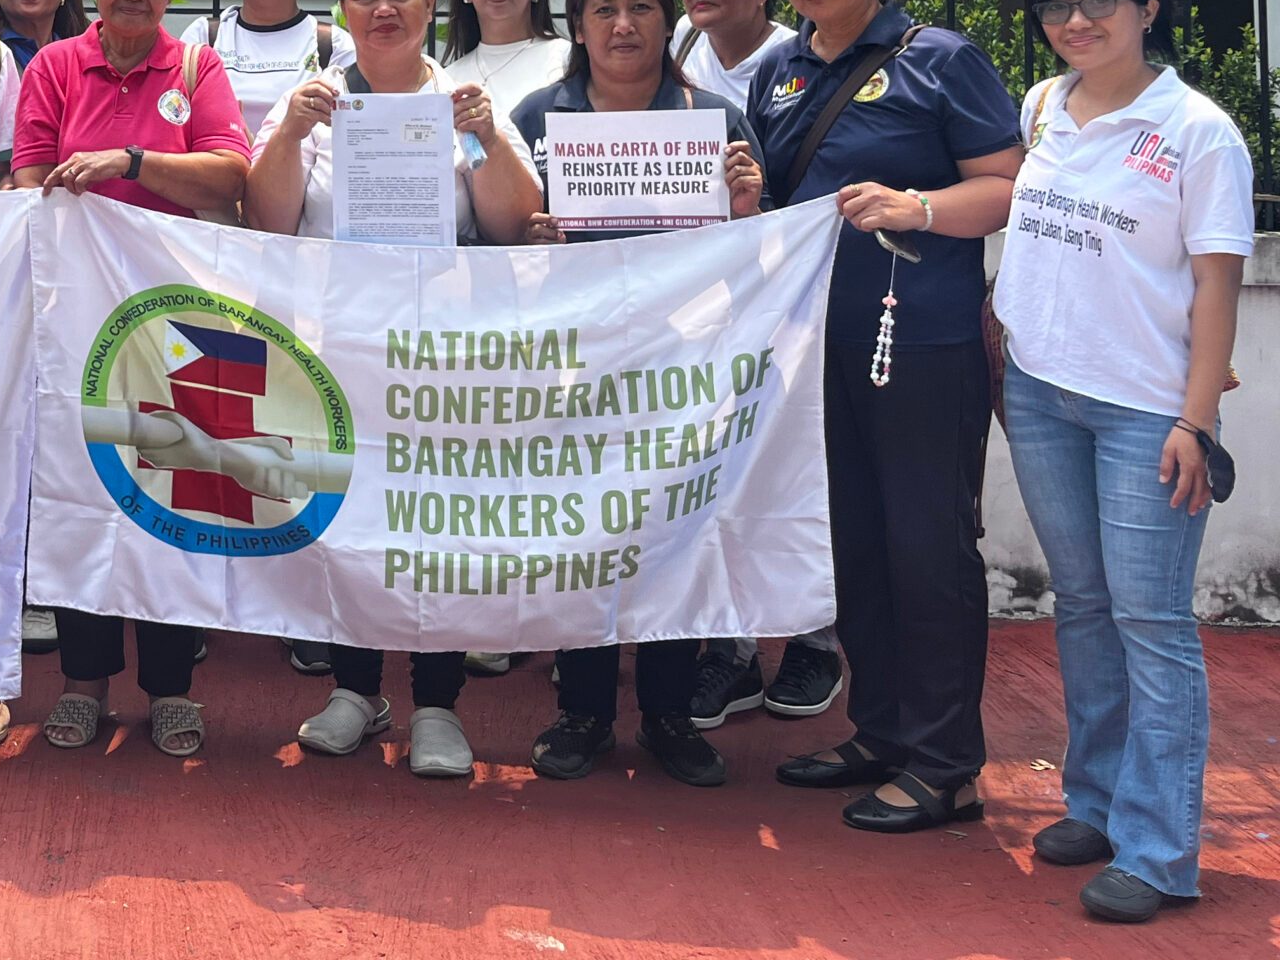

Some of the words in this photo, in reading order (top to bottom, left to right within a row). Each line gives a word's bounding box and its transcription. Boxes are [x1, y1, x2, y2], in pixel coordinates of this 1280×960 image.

[554, 142, 605, 157] MAGNA
[610, 142, 658, 157] CARTA
[664, 141, 681, 156] OF
[687, 141, 720, 156] BHW
[1130, 131, 1165, 160] UNI
[1161, 145, 1182, 159] global
[562, 162, 639, 177] REINSTATE
[643, 162, 662, 176] AS
[668, 161, 713, 176] LEDAC
[1122, 155, 1174, 183] PILIPINAS
[568, 182, 636, 196] PRIORITY
[641, 181, 709, 195] MEASURE
[1046, 189, 1077, 219] Barangay
[1076, 198, 1100, 221] Health
[588, 219, 602, 227] BHW
[1018, 212, 1040, 239] Isang
[1064, 224, 1083, 251] Isang
[1085, 230, 1103, 257] Tinig
[386, 327, 587, 371] NATIONAL
[86, 337, 114, 397] NATIONAL
[109, 294, 195, 336] CONFEDERATION
[197, 296, 215, 308] OF
[218, 302, 289, 344] BARANGAY
[288, 344, 327, 385] HEALTH
[323, 385, 347, 450] WORKERS
[385, 363, 717, 425] CONFEDERATION
[730, 345, 777, 398] OF
[386, 429, 604, 478] BARANGAY
[624, 400, 760, 472] HEALTH
[384, 488, 586, 538] WORKERS
[600, 486, 651, 535] OF
[664, 464, 723, 523] THE
[120, 495, 145, 517] OF
[152, 515, 186, 540] THE
[196, 525, 311, 550] PHILIPPINES
[385, 543, 642, 597] PHILIPPINES
